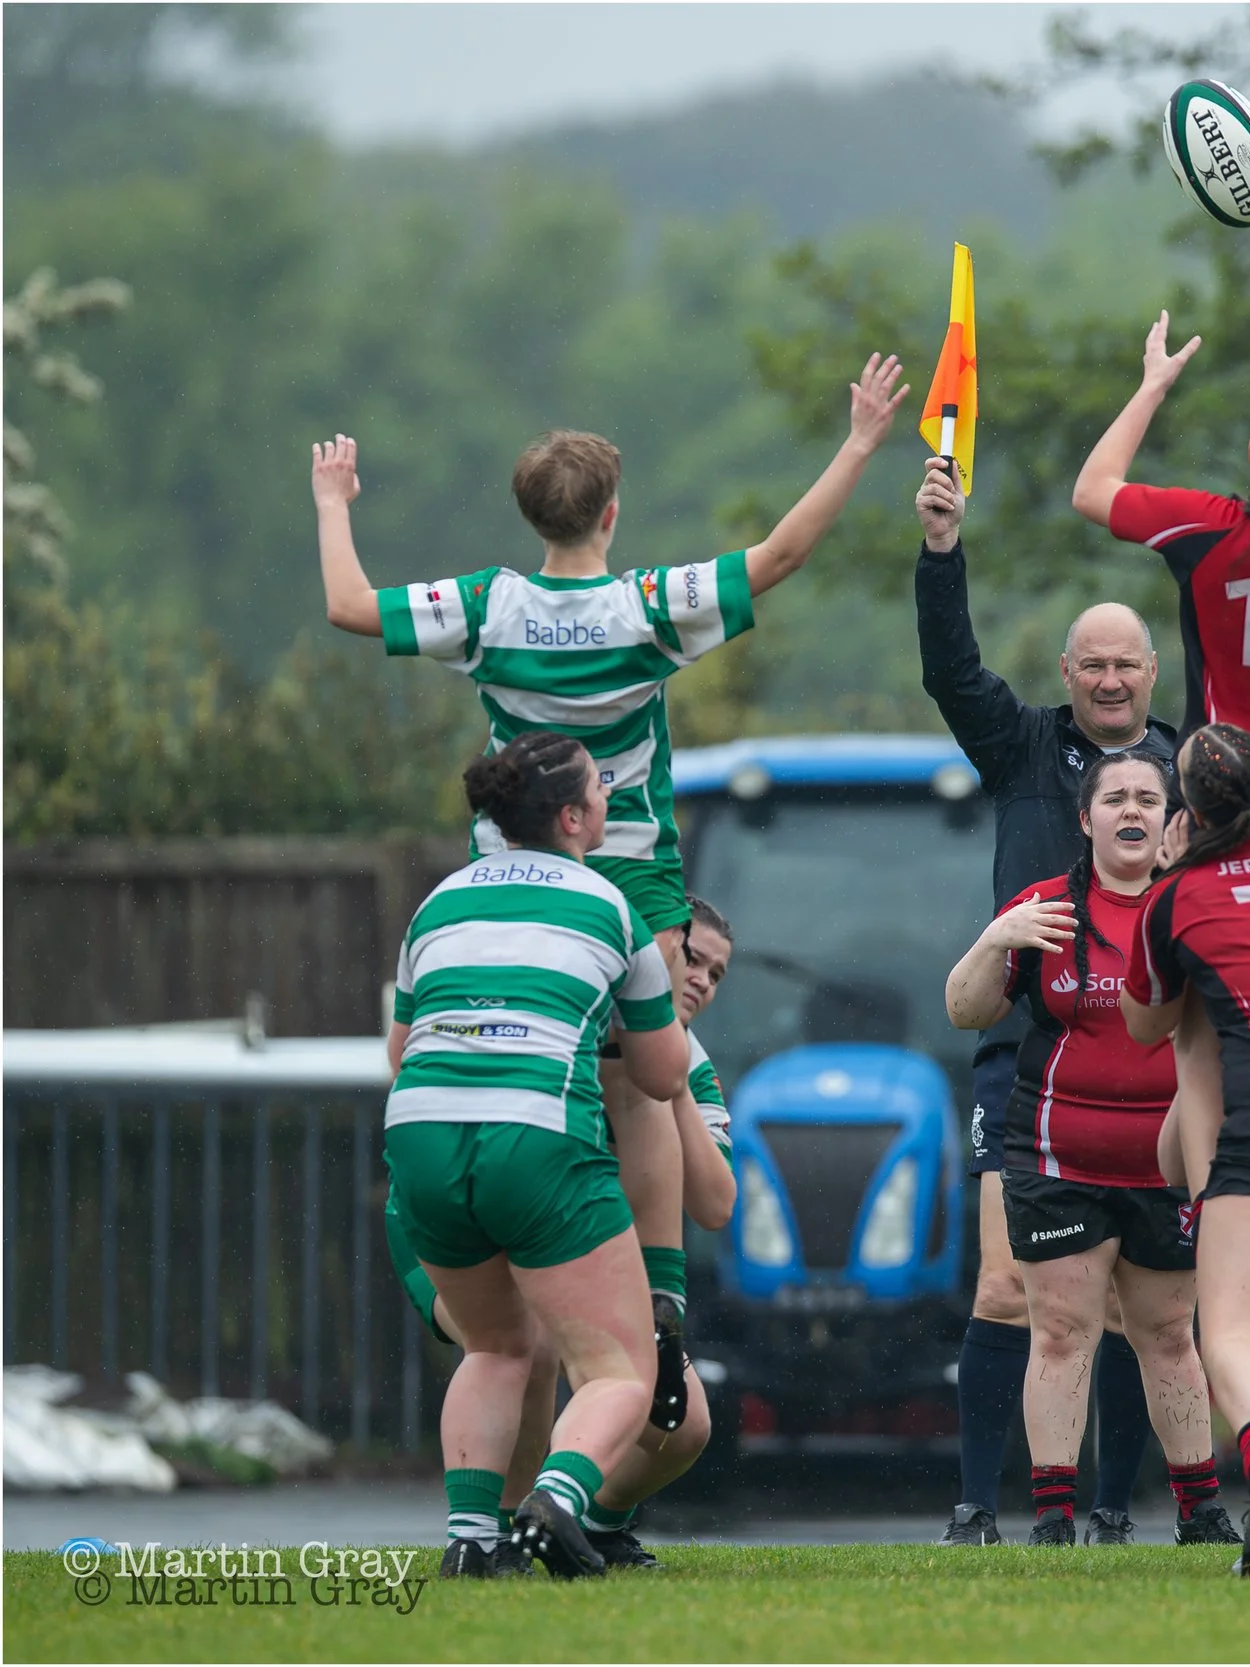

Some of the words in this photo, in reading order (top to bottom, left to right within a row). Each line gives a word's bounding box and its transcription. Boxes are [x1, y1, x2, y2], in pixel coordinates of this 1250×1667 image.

[525, 618, 606, 645] Babbé
[470, 863, 564, 884] Babbé
[482, 1026, 493, 1036] &
[495, 1025, 527, 1037] SON
[1039, 1223, 1085, 1241] SAMURAI
